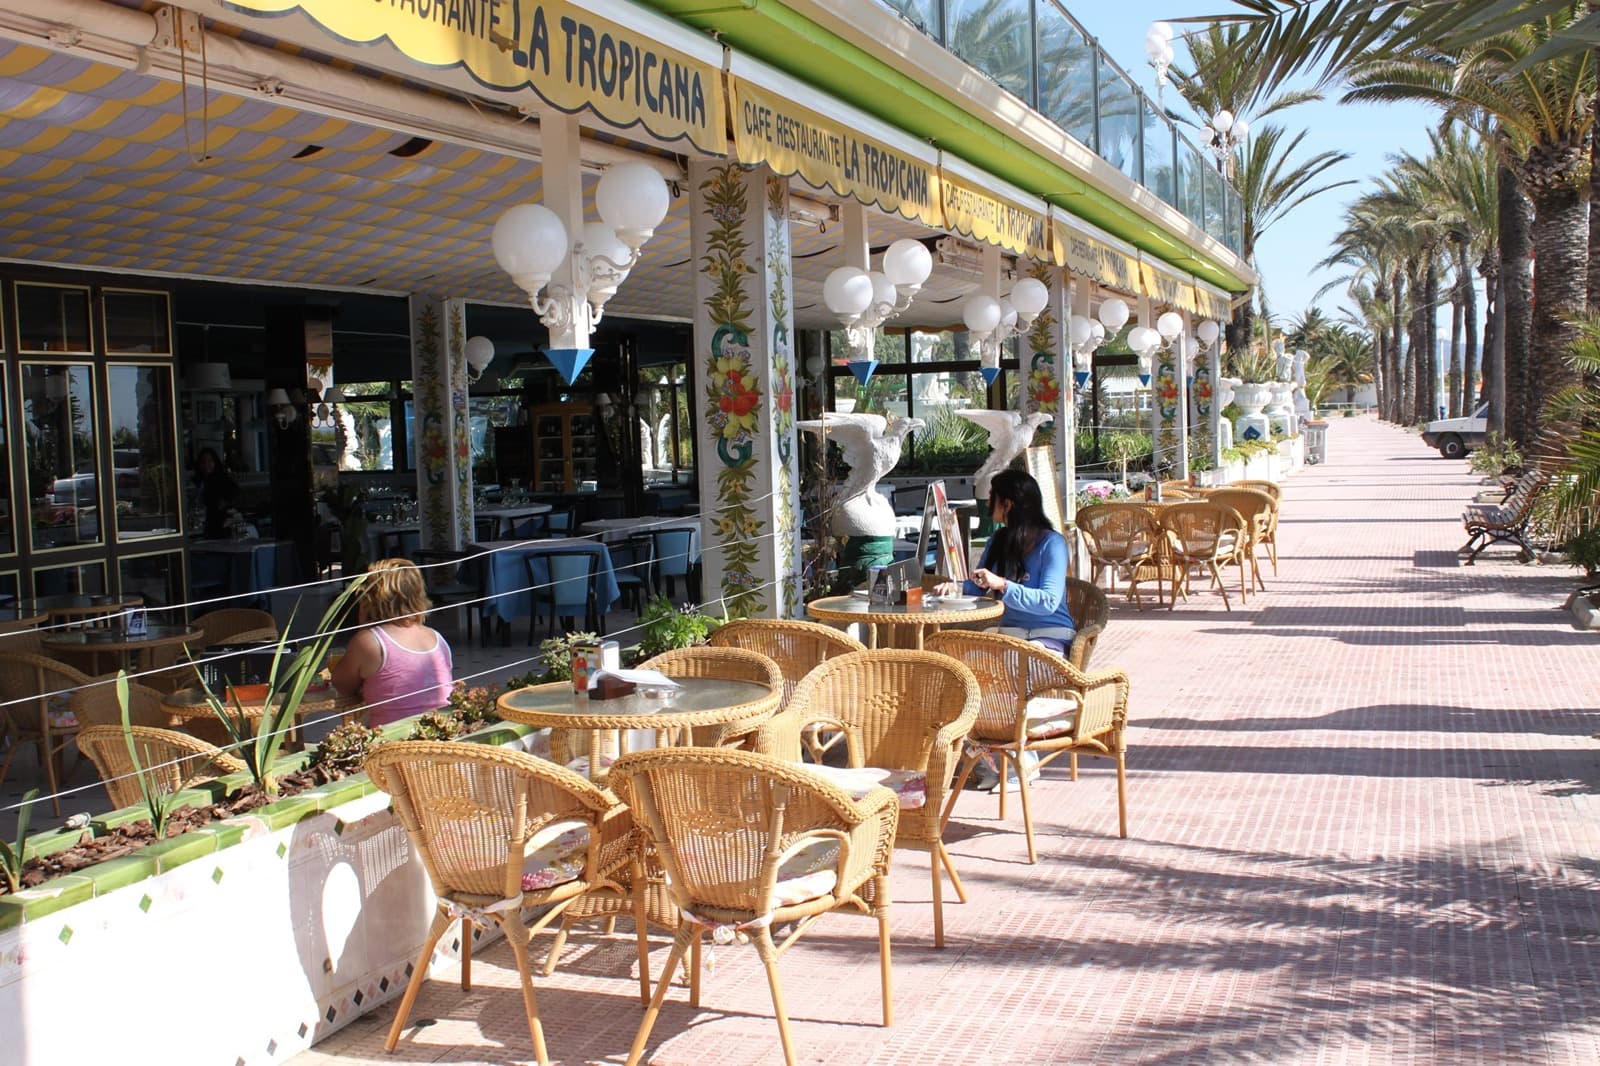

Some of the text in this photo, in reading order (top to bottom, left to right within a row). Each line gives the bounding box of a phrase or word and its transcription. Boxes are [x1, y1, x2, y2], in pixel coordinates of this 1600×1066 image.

[513, 0, 550, 75] LA
[561, 16, 705, 128] TROPICANA
[744, 100, 928, 207] CAFE RESTAURANTE LA TROPICANA
